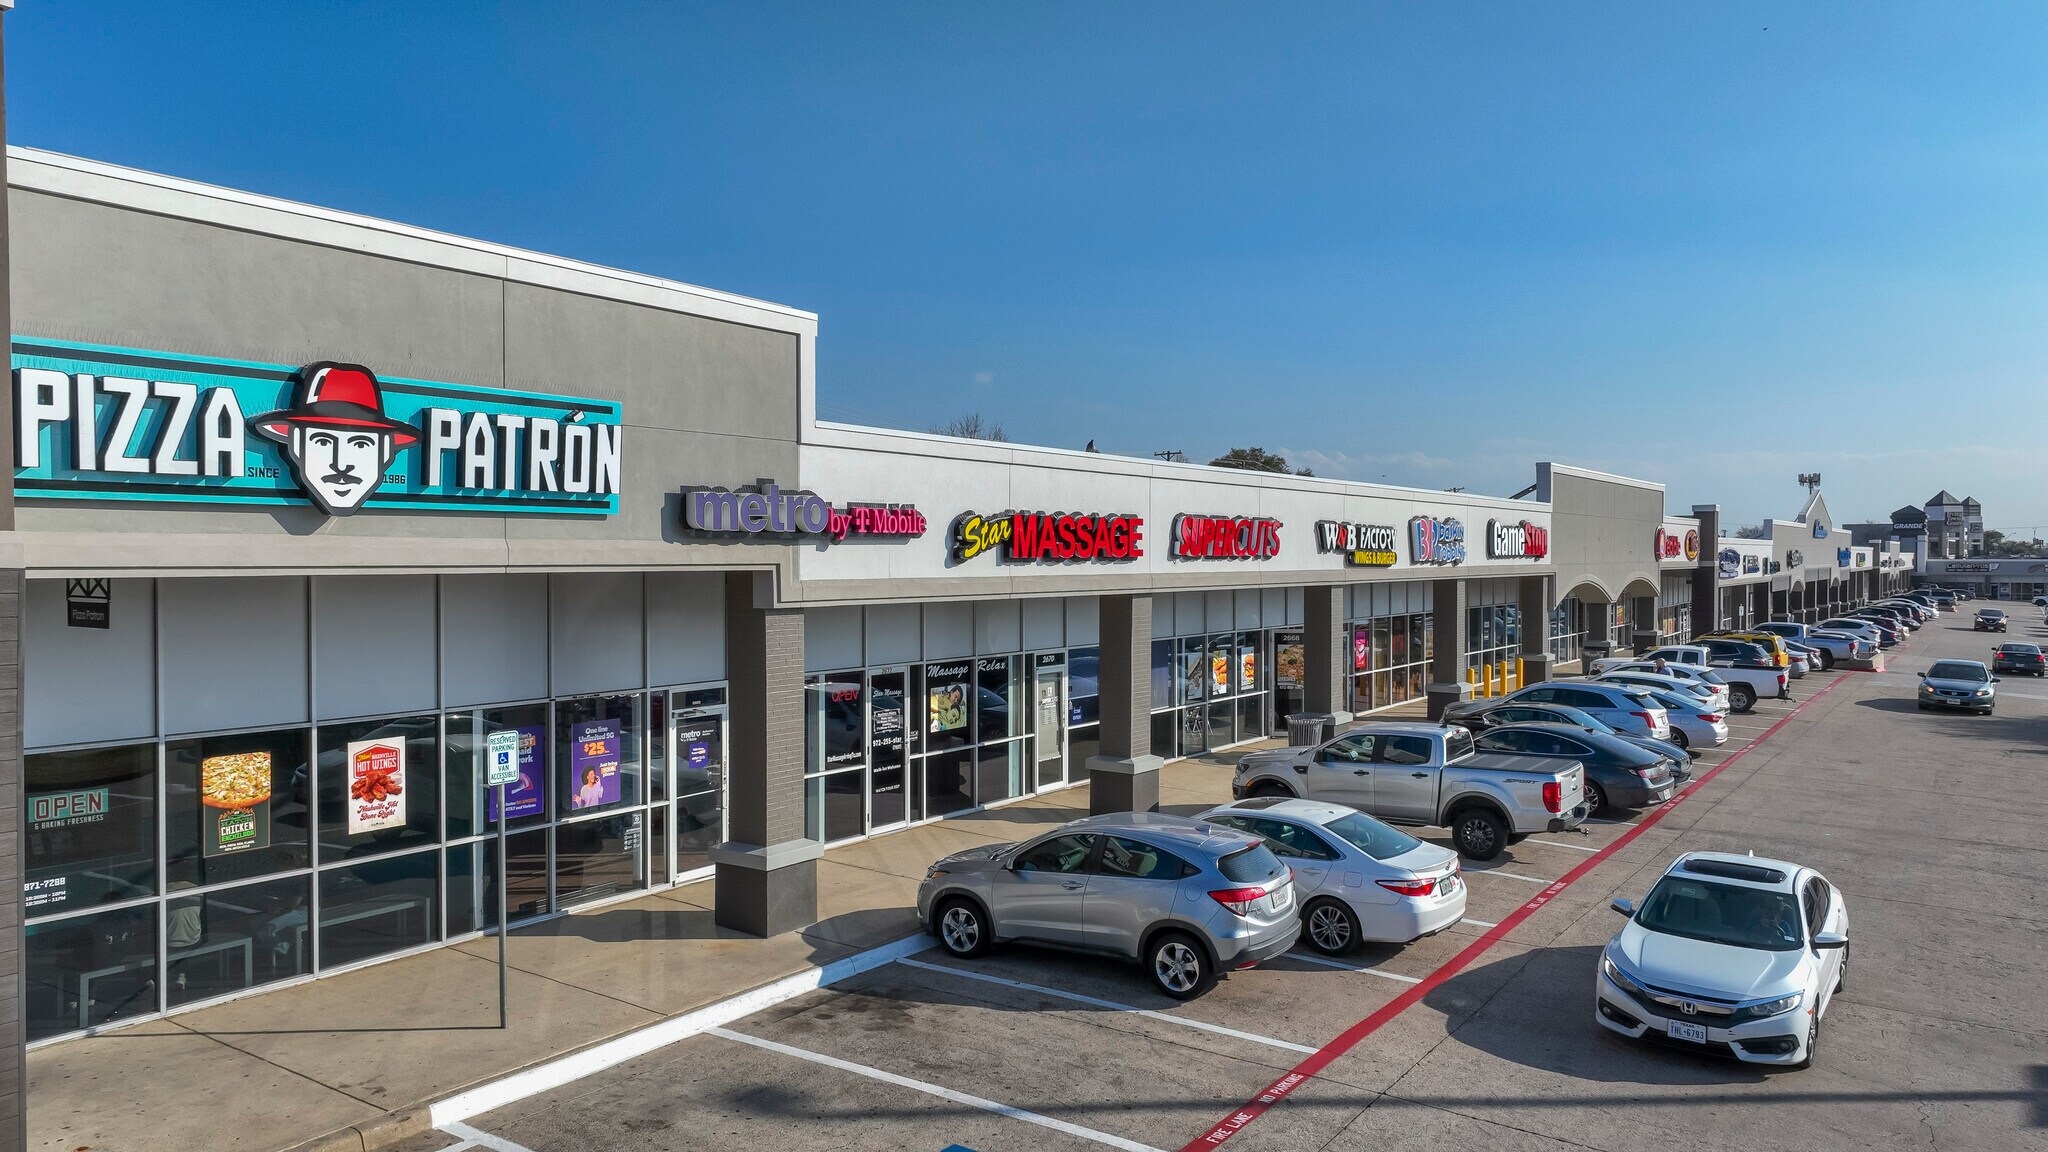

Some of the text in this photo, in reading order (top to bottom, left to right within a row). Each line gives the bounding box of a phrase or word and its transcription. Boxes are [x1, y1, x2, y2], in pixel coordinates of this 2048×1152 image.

[16, 366, 622, 494] PIZZA PATRÓN
[247, 466, 280, 479] SINCE
[382, 473, 406, 485] 1986
[685, 484, 829, 533] metro
[827, 502, 852, 540] by
[1893, 522, 1924, 530] GRANDE
[963, 513, 1144, 560] Star MASSAGE
[1176, 515, 1281, 557] SUPERCUTS
[1323, 523, 1397, 550] WNB FACTORY
[1354, 551, 1372, 564] WINGS
[1377, 551, 1396, 565] BURGER
[927, 659, 1007, 678] Massage Relax
[831, 688, 859, 702] OPEN
[872, 688, 902, 698] Star Massage
[578, 731, 615, 743] Unlimited 5G
[585, 726, 609, 735] One line
[680, 730, 701, 739] metro
[489, 735, 516, 745] RESERVED
[491, 743, 515, 753] PARKING
[583, 741, 605, 756] $25
[357, 758, 397, 773] HOT WINGS
[497, 764, 510, 772] VAN
[491, 770, 517, 781] ACCESSIBLE
[34, 791, 104, 821] OPEN
[41, 820, 65, 830] BAKING
[67, 814, 104, 825] FRESHNESS
[221, 821, 254, 836] CHICKEN
[1205, 1073, 1304, 1144] FIRE LANE NO PARKING
